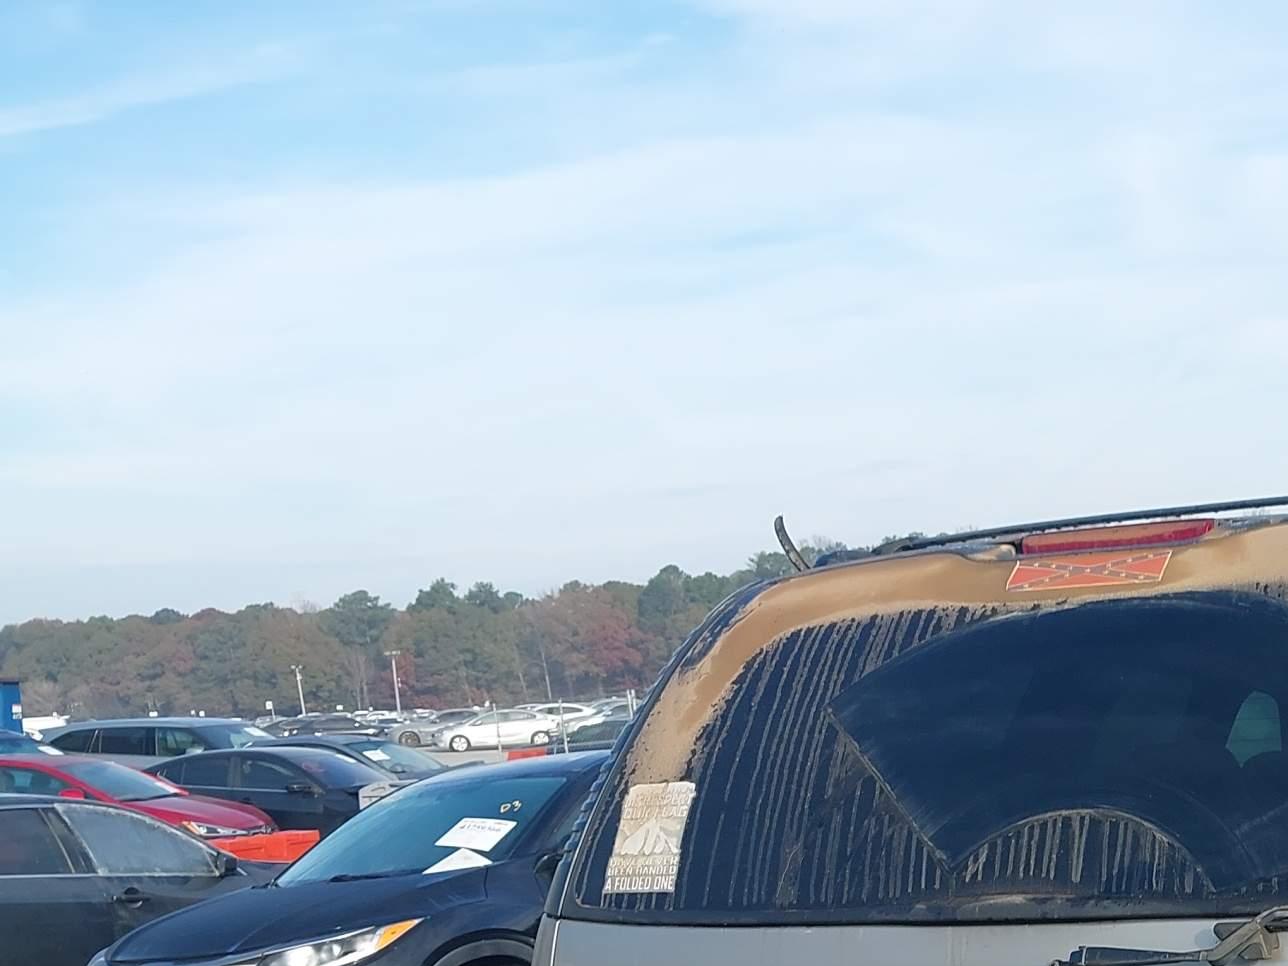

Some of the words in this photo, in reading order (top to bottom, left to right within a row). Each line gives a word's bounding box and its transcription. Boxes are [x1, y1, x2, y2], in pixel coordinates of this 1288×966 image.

[607, 865, 633, 876] BEEN
[605, 878, 612, 890] A
[614, 876, 652, 890] FOLDED
[653, 875, 675, 890] ONE
